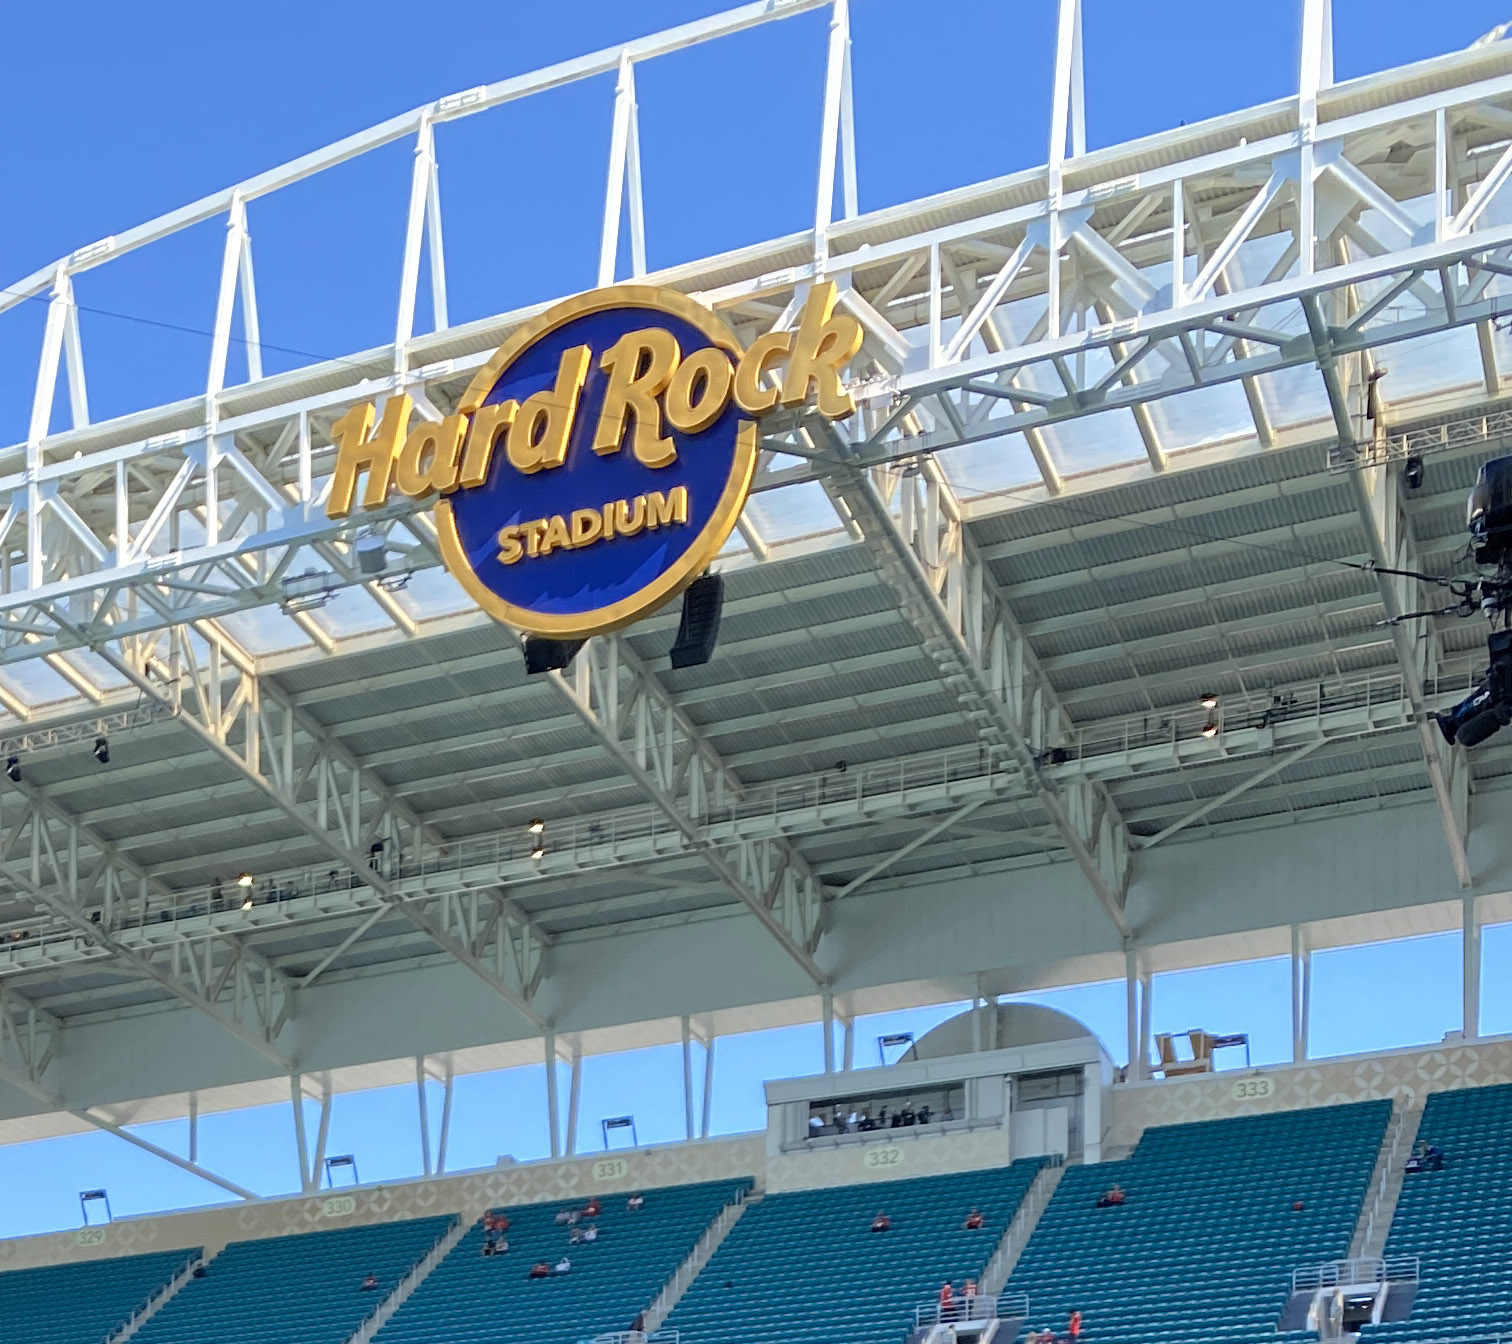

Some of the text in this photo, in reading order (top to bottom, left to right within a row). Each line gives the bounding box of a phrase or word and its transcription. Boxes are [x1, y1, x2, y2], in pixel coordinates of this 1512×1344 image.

[325, 280, 865, 520] Hard Rock
[496, 485, 688, 565] STADIUM
[1236, 1080, 1270, 1099] 333
[868, 1148, 900, 1167] 332
[597, 1160, 624, 1177] 331
[325, 1198, 352, 1216] 330
[79, 1229, 103, 1245] 329
